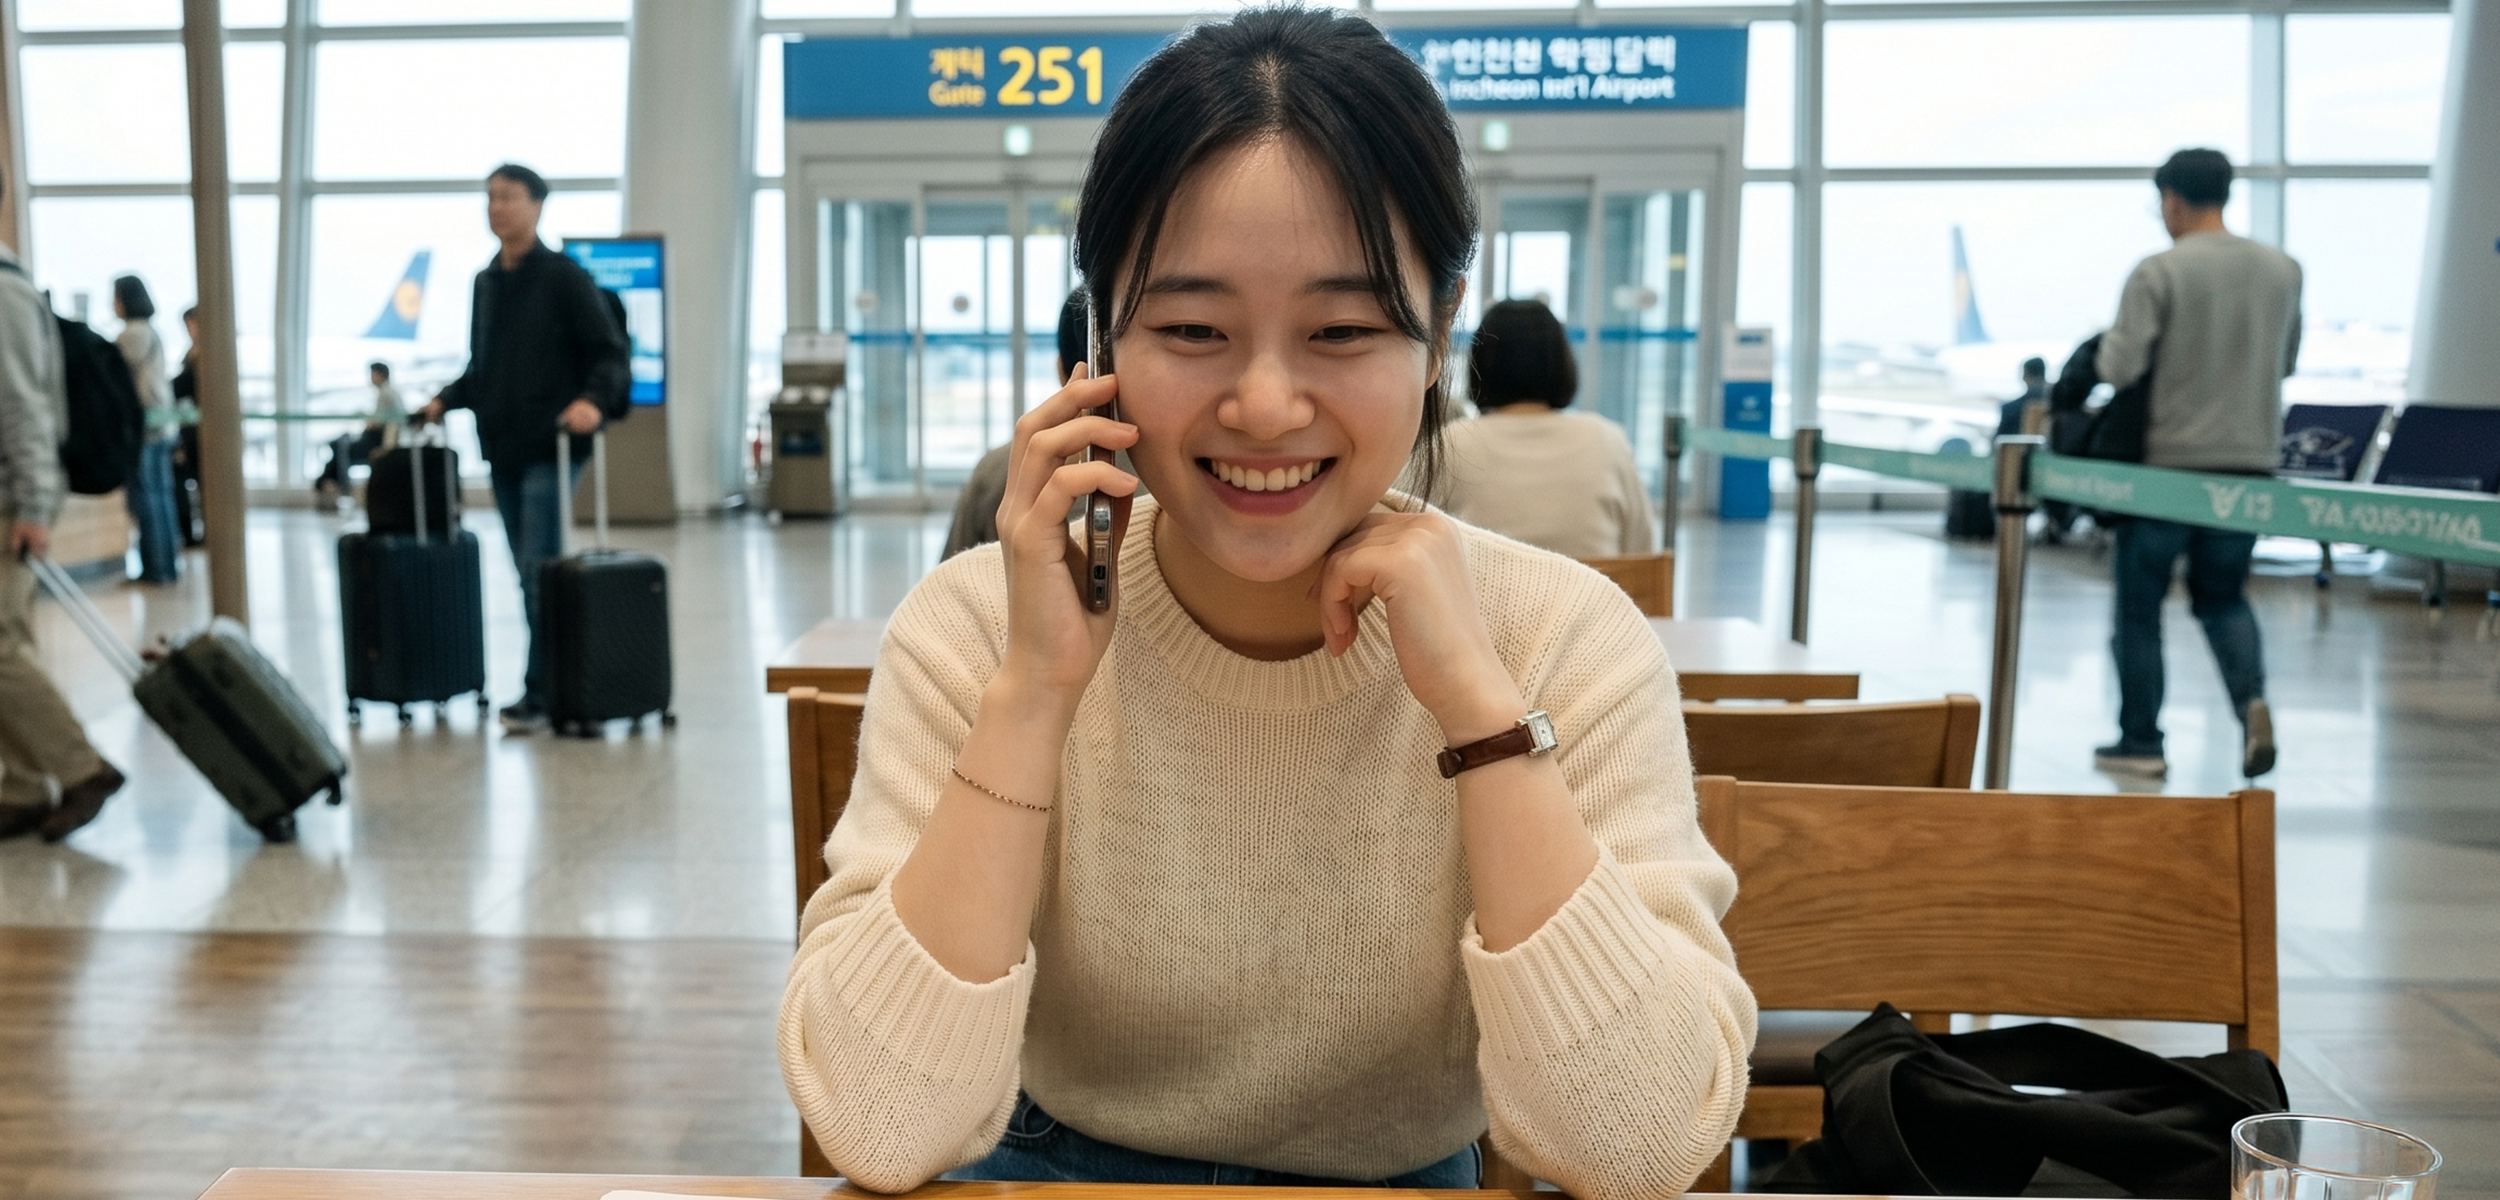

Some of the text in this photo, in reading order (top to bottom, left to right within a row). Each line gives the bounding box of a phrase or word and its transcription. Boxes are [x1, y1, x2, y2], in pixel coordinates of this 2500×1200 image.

[997, 46, 1103, 106] 251
[1592, 74, 1675, 103] Airport
[928, 80, 987, 107] Gate
